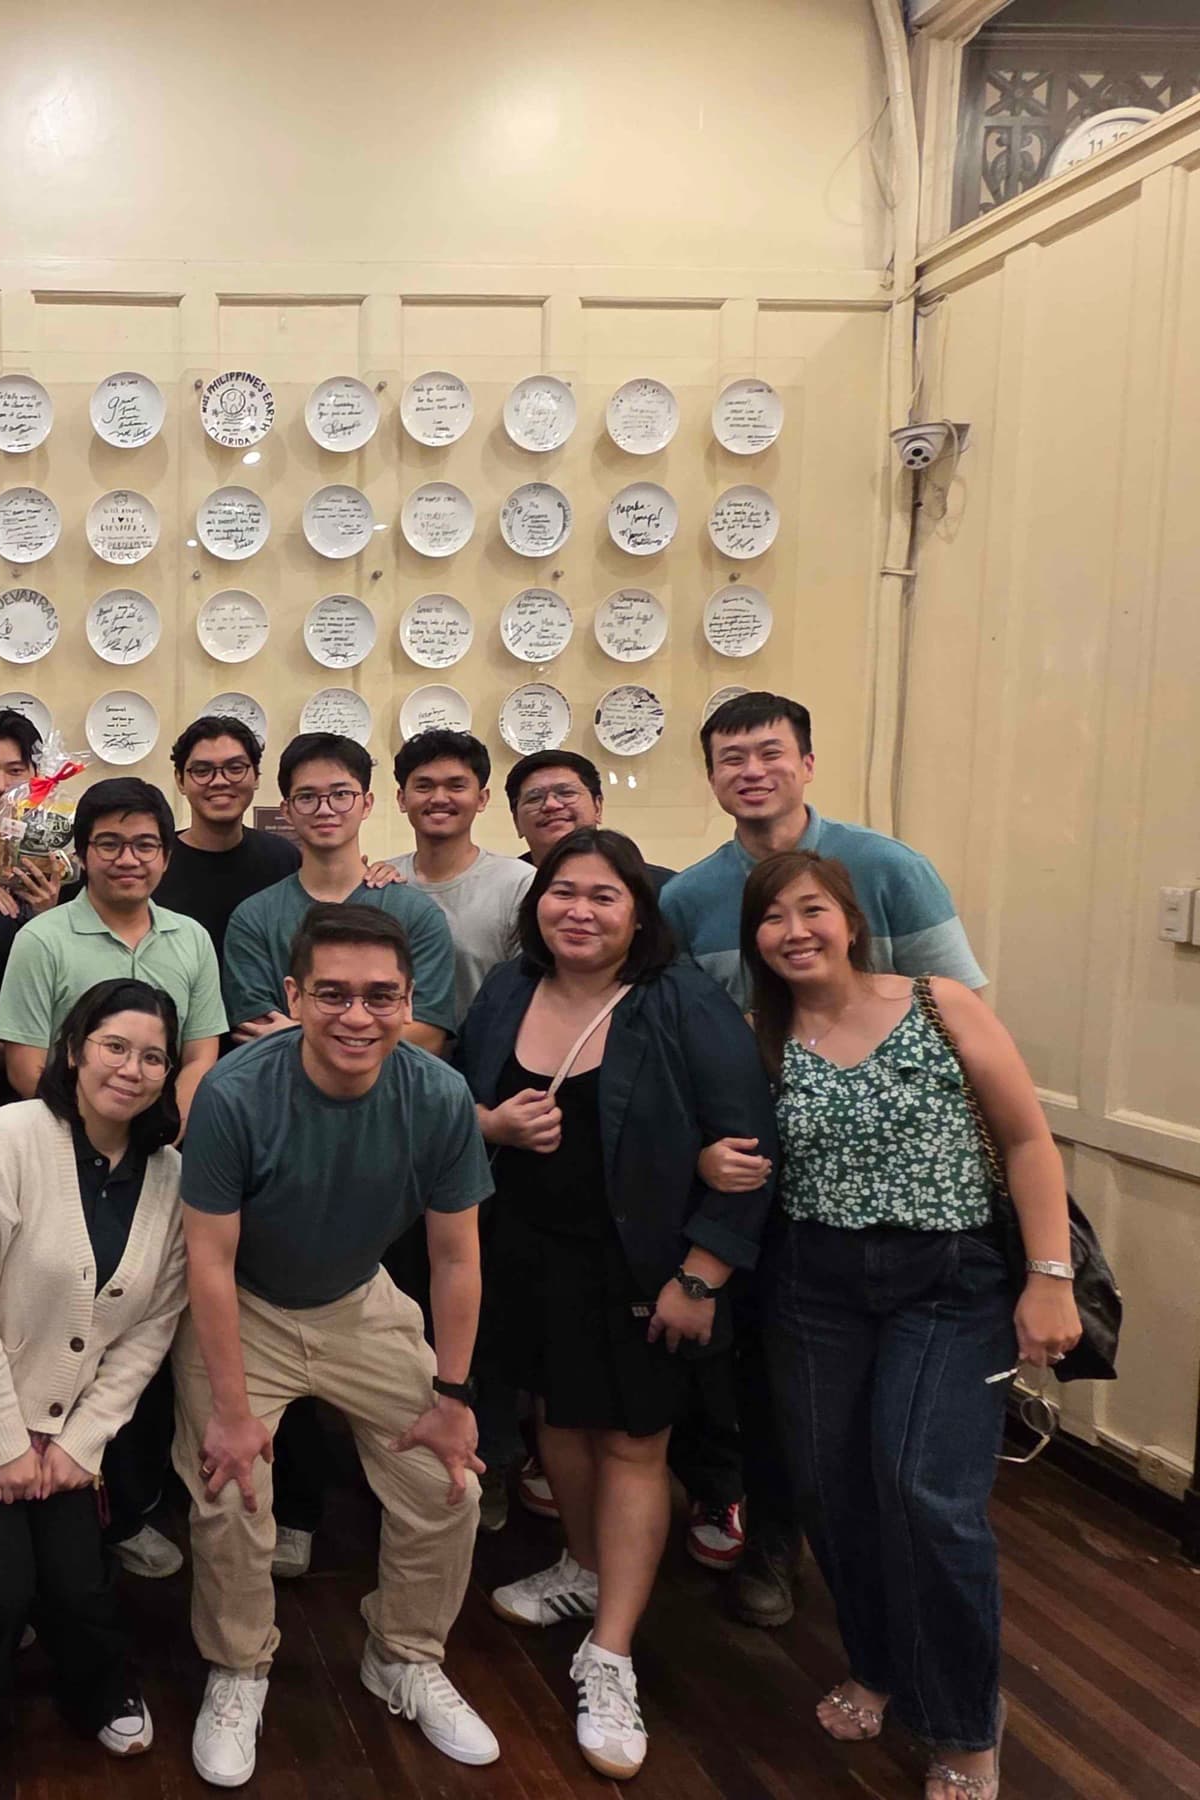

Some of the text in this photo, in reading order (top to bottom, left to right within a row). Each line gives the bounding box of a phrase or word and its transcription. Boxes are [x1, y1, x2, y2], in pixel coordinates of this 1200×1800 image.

[208, 371, 266, 396] PHILIPPINES
[262, 392, 275, 432] EARTH
[208, 426, 251, 446] FLORIDA
